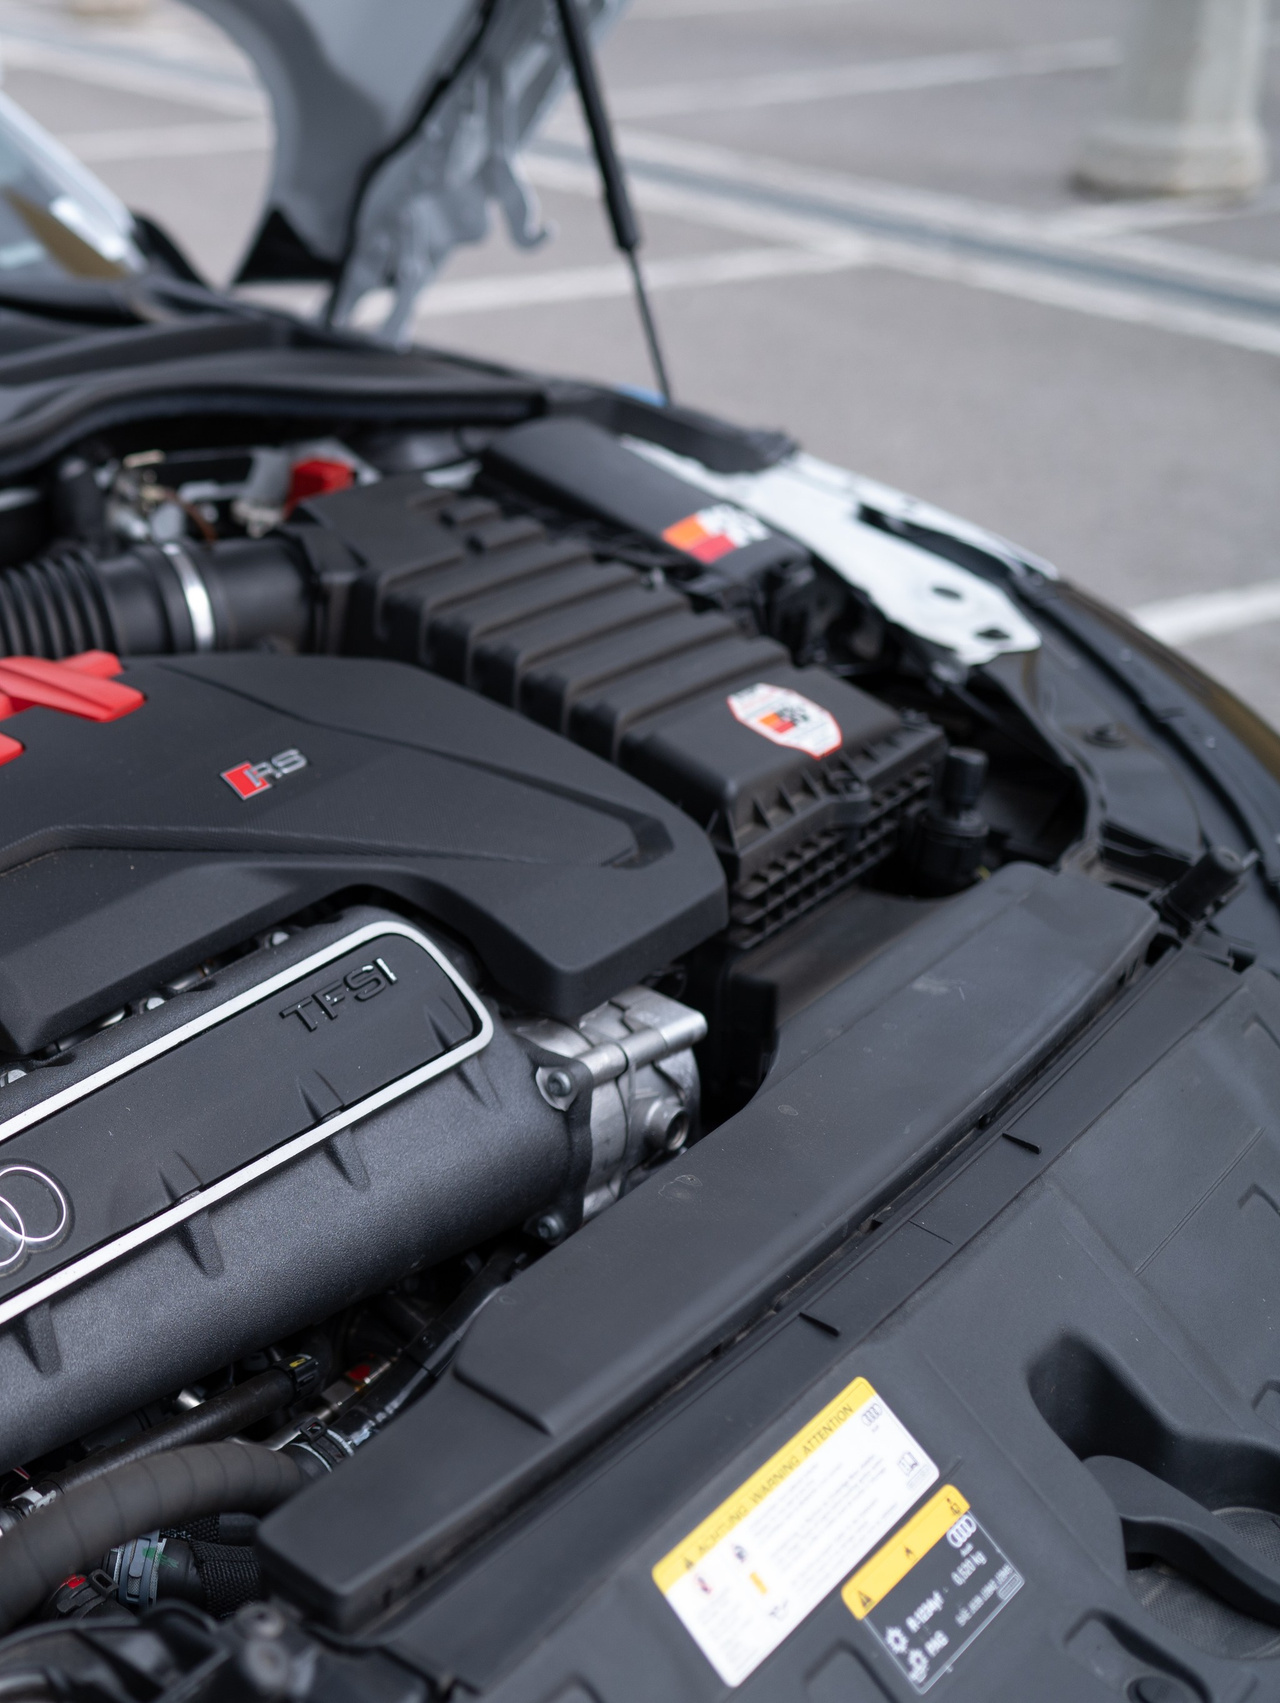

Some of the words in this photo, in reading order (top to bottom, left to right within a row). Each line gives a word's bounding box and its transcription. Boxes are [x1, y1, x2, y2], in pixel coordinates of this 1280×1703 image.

[242, 748, 308, 788] RS
[278, 957, 398, 1032] TFSI
[748, 1454, 801, 1505] WARNING
[800, 1403, 854, 1456] ATTENTION
[922, 1627, 950, 1659] PAG
